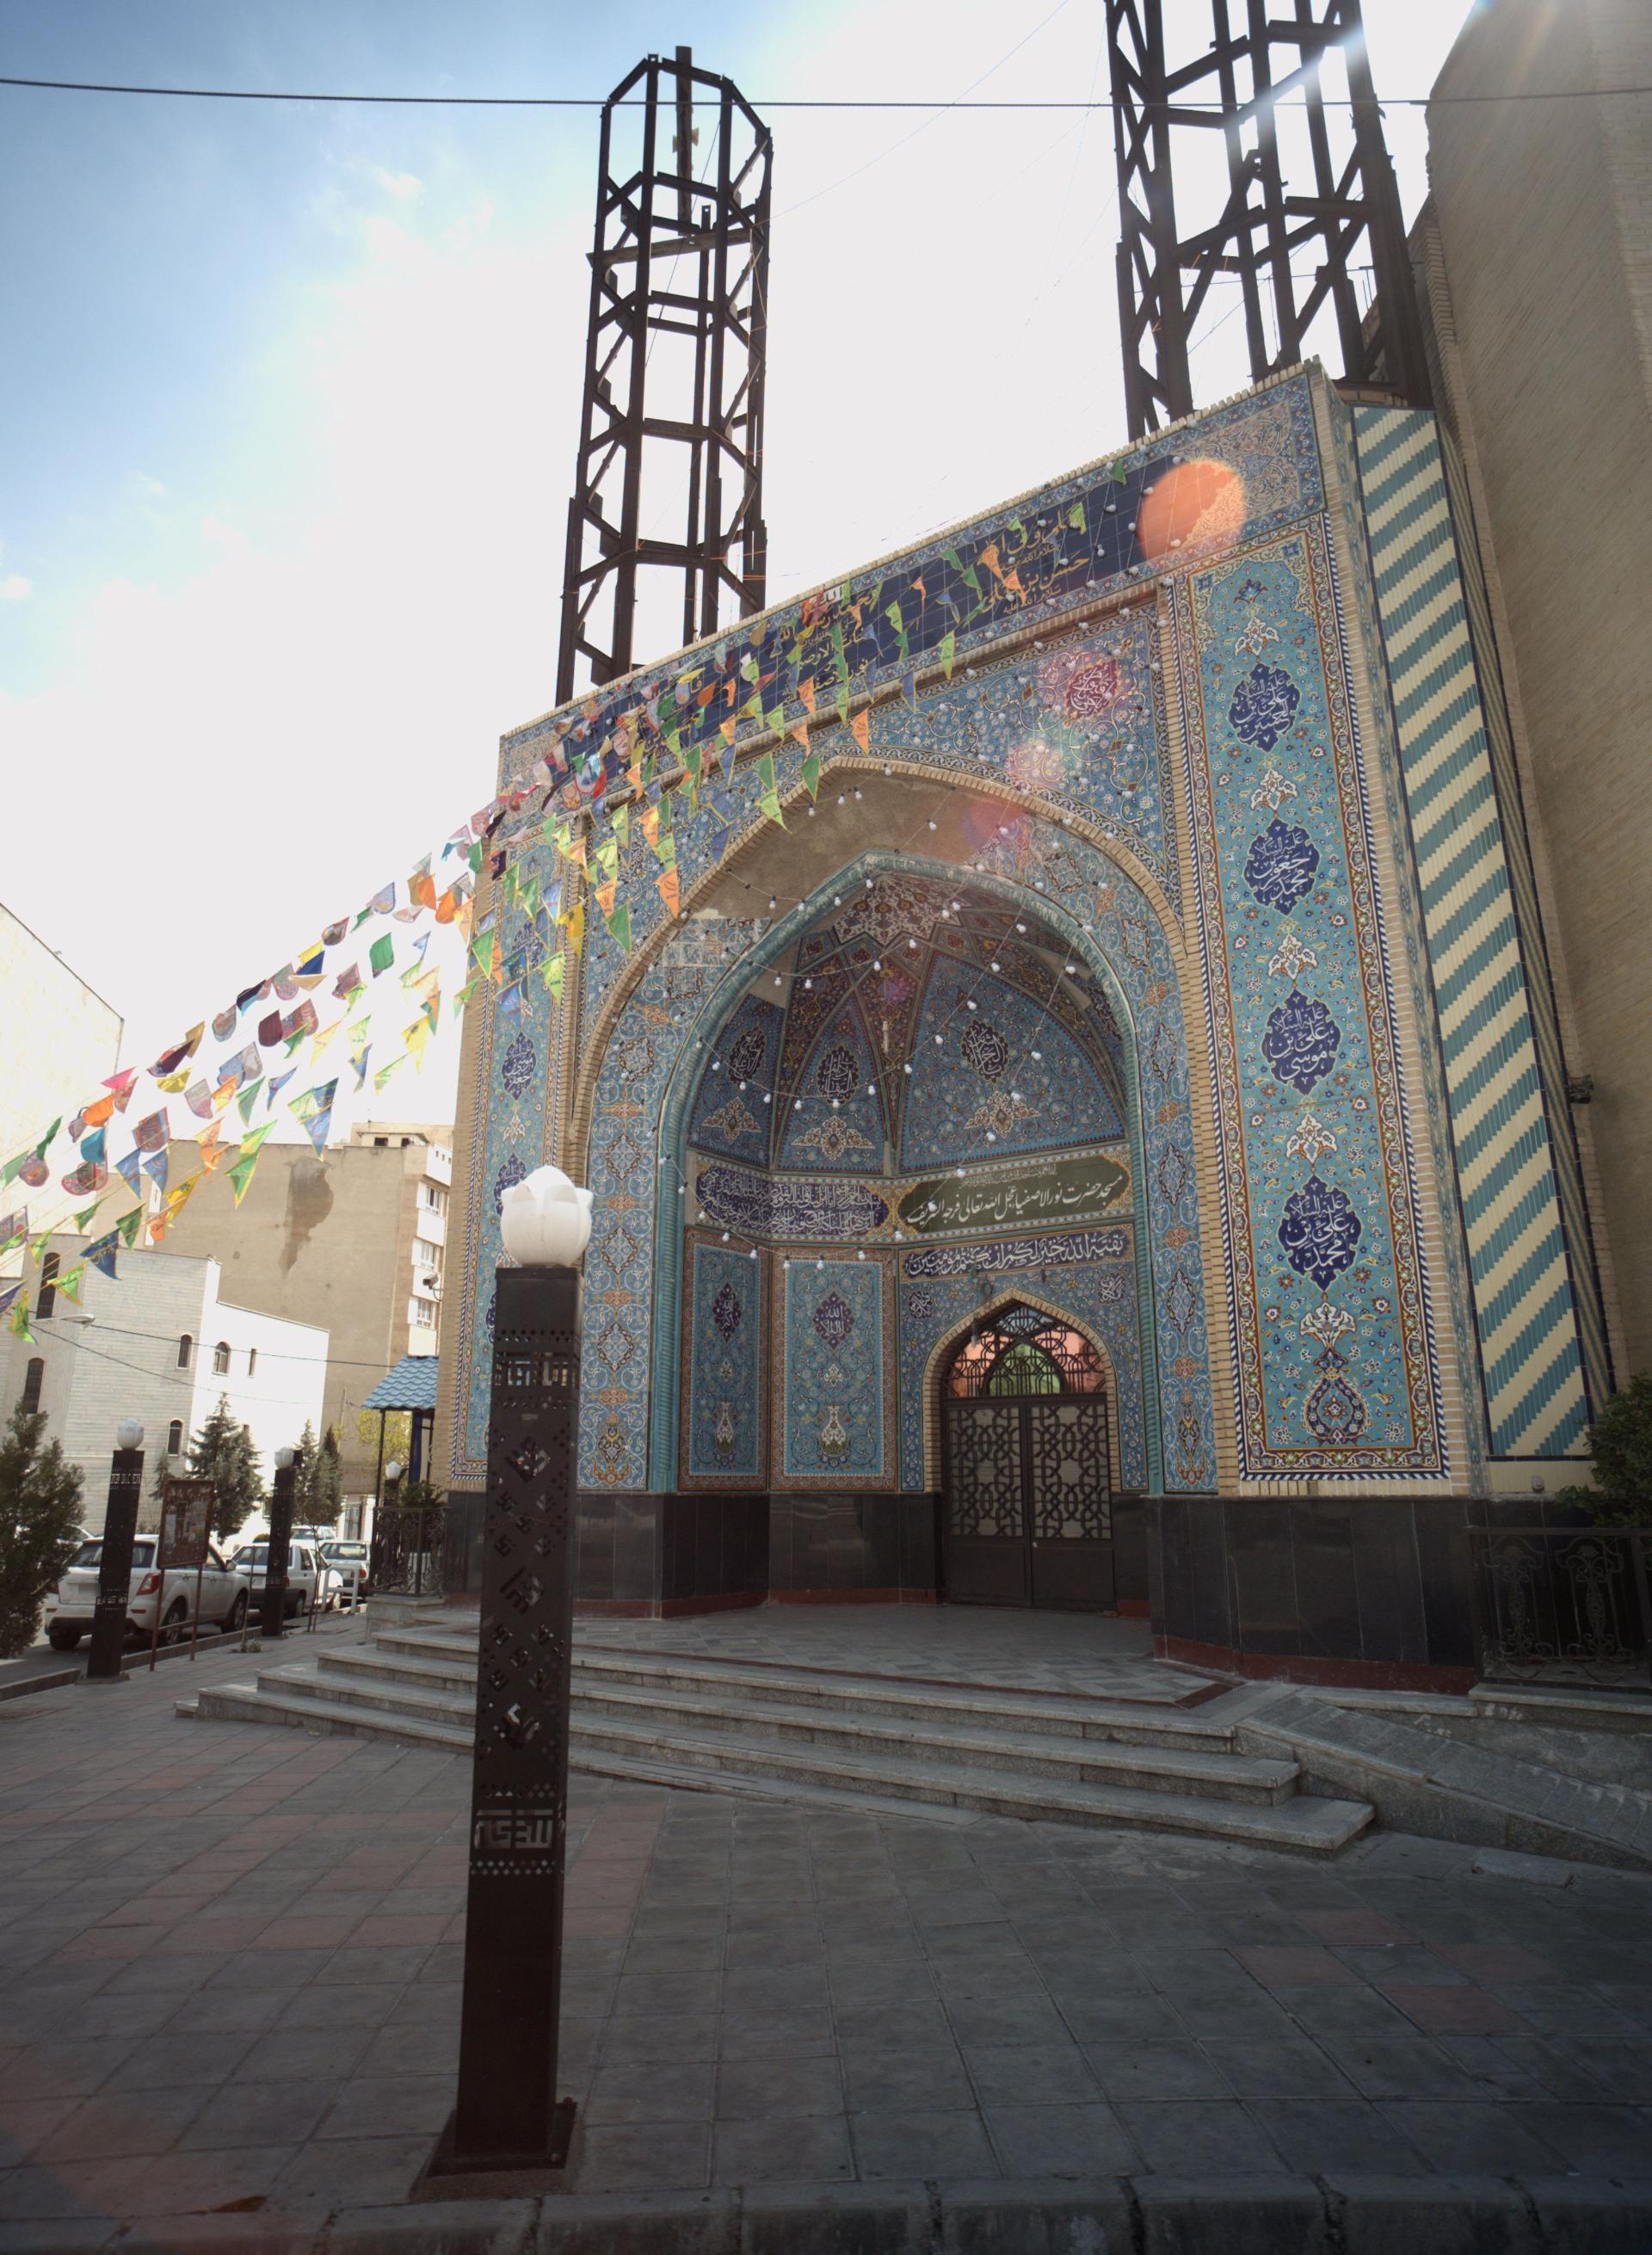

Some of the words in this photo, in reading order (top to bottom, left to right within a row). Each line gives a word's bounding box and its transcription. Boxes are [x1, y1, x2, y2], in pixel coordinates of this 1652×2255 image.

[1270, 869, 1309, 900] محمد
[1062, 1181, 1102, 1208] حضرت
[1095, 1175, 1123, 1207] مسجد
[1304, 1240, 1346, 1271] محمد
